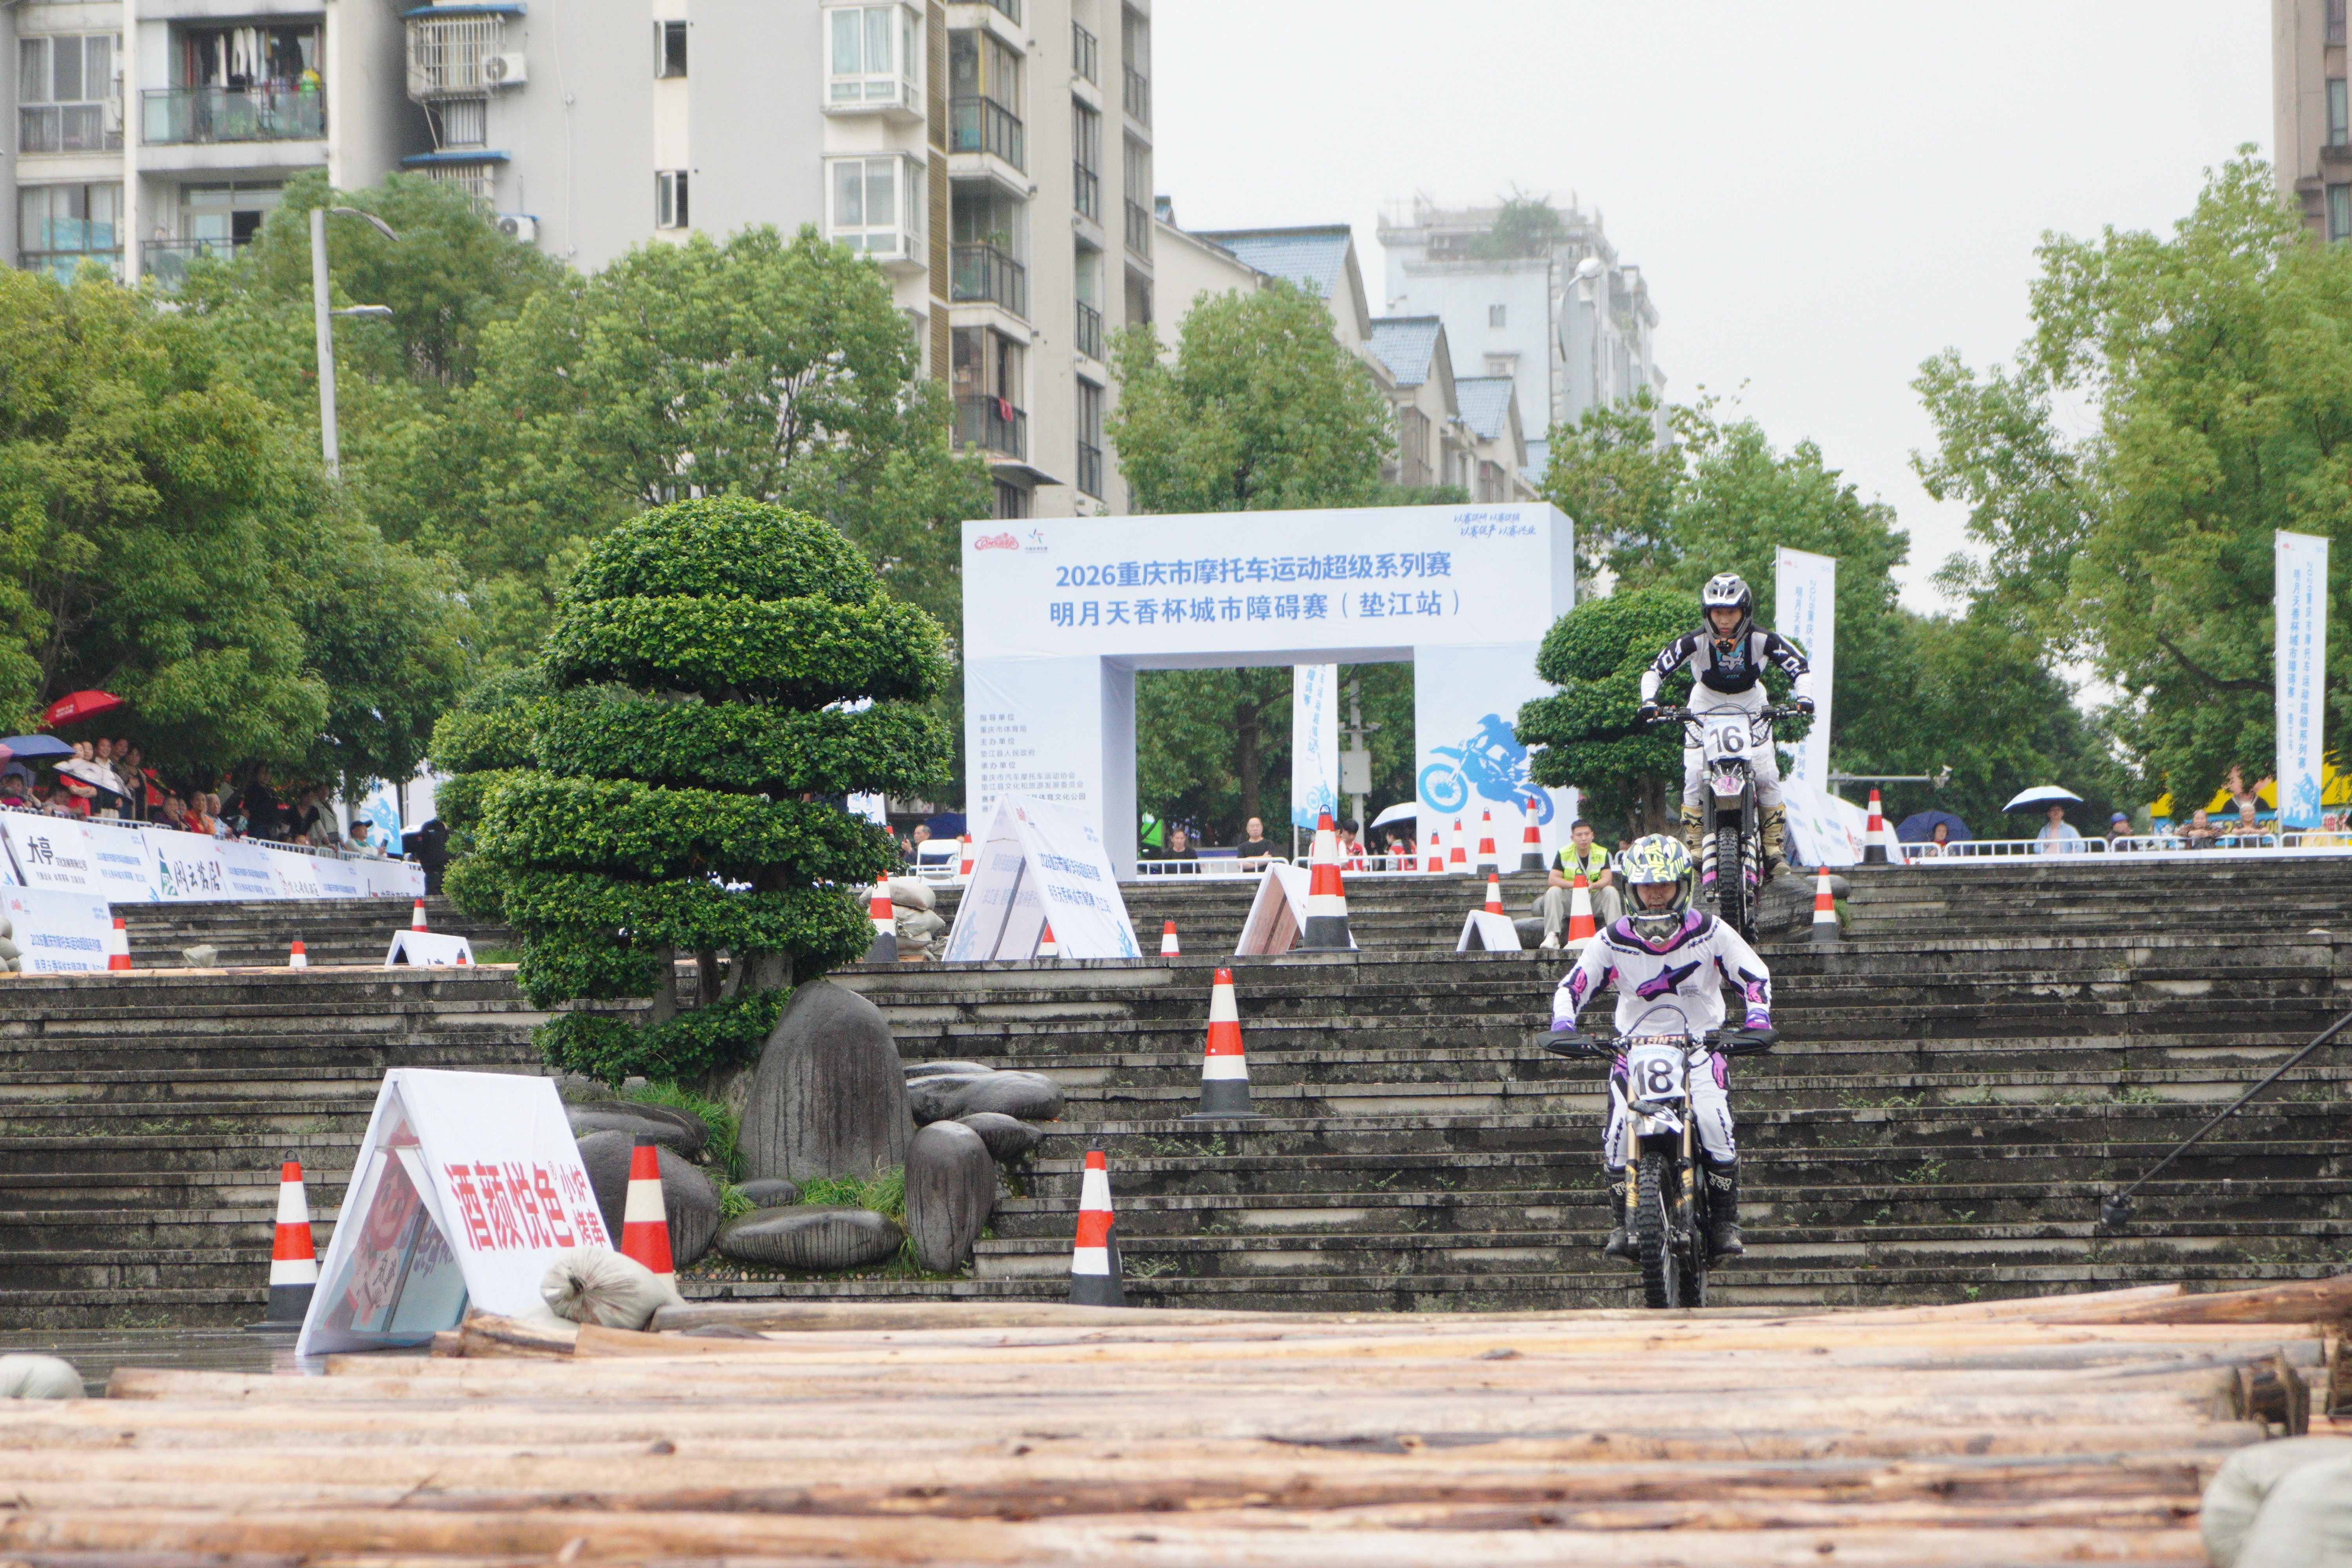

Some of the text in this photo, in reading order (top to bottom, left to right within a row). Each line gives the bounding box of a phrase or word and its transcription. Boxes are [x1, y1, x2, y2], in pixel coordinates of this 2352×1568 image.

[1056, 551, 1452, 587] 2026重庆市摩托车运动超级系列赛
[1050, 589, 1459, 627] 明月天香杯城市障碍赛（垫江站）
[980, 713, 1015, 722] 指导单位
[980, 725, 1027, 734] 重庆市体育局
[980, 737, 1015, 746] 主办单位
[1710, 726, 1744, 753] 16
[981, 749, 1035, 758] 垫江县人民政府
[981, 761, 1016, 770] 承办单位
[981, 771, 1075, 782] 重庆市汽车摩托车运动协会
[981, 780, 1084, 791] 垫江县文化和旅游发展委员会
[1633, 1058, 1674, 1095] 18
[560, 1163, 587, 1204] 小炉
[443, 1160, 575, 1251] 酒颜悦色
[572, 1209, 606, 1248] 烤串
